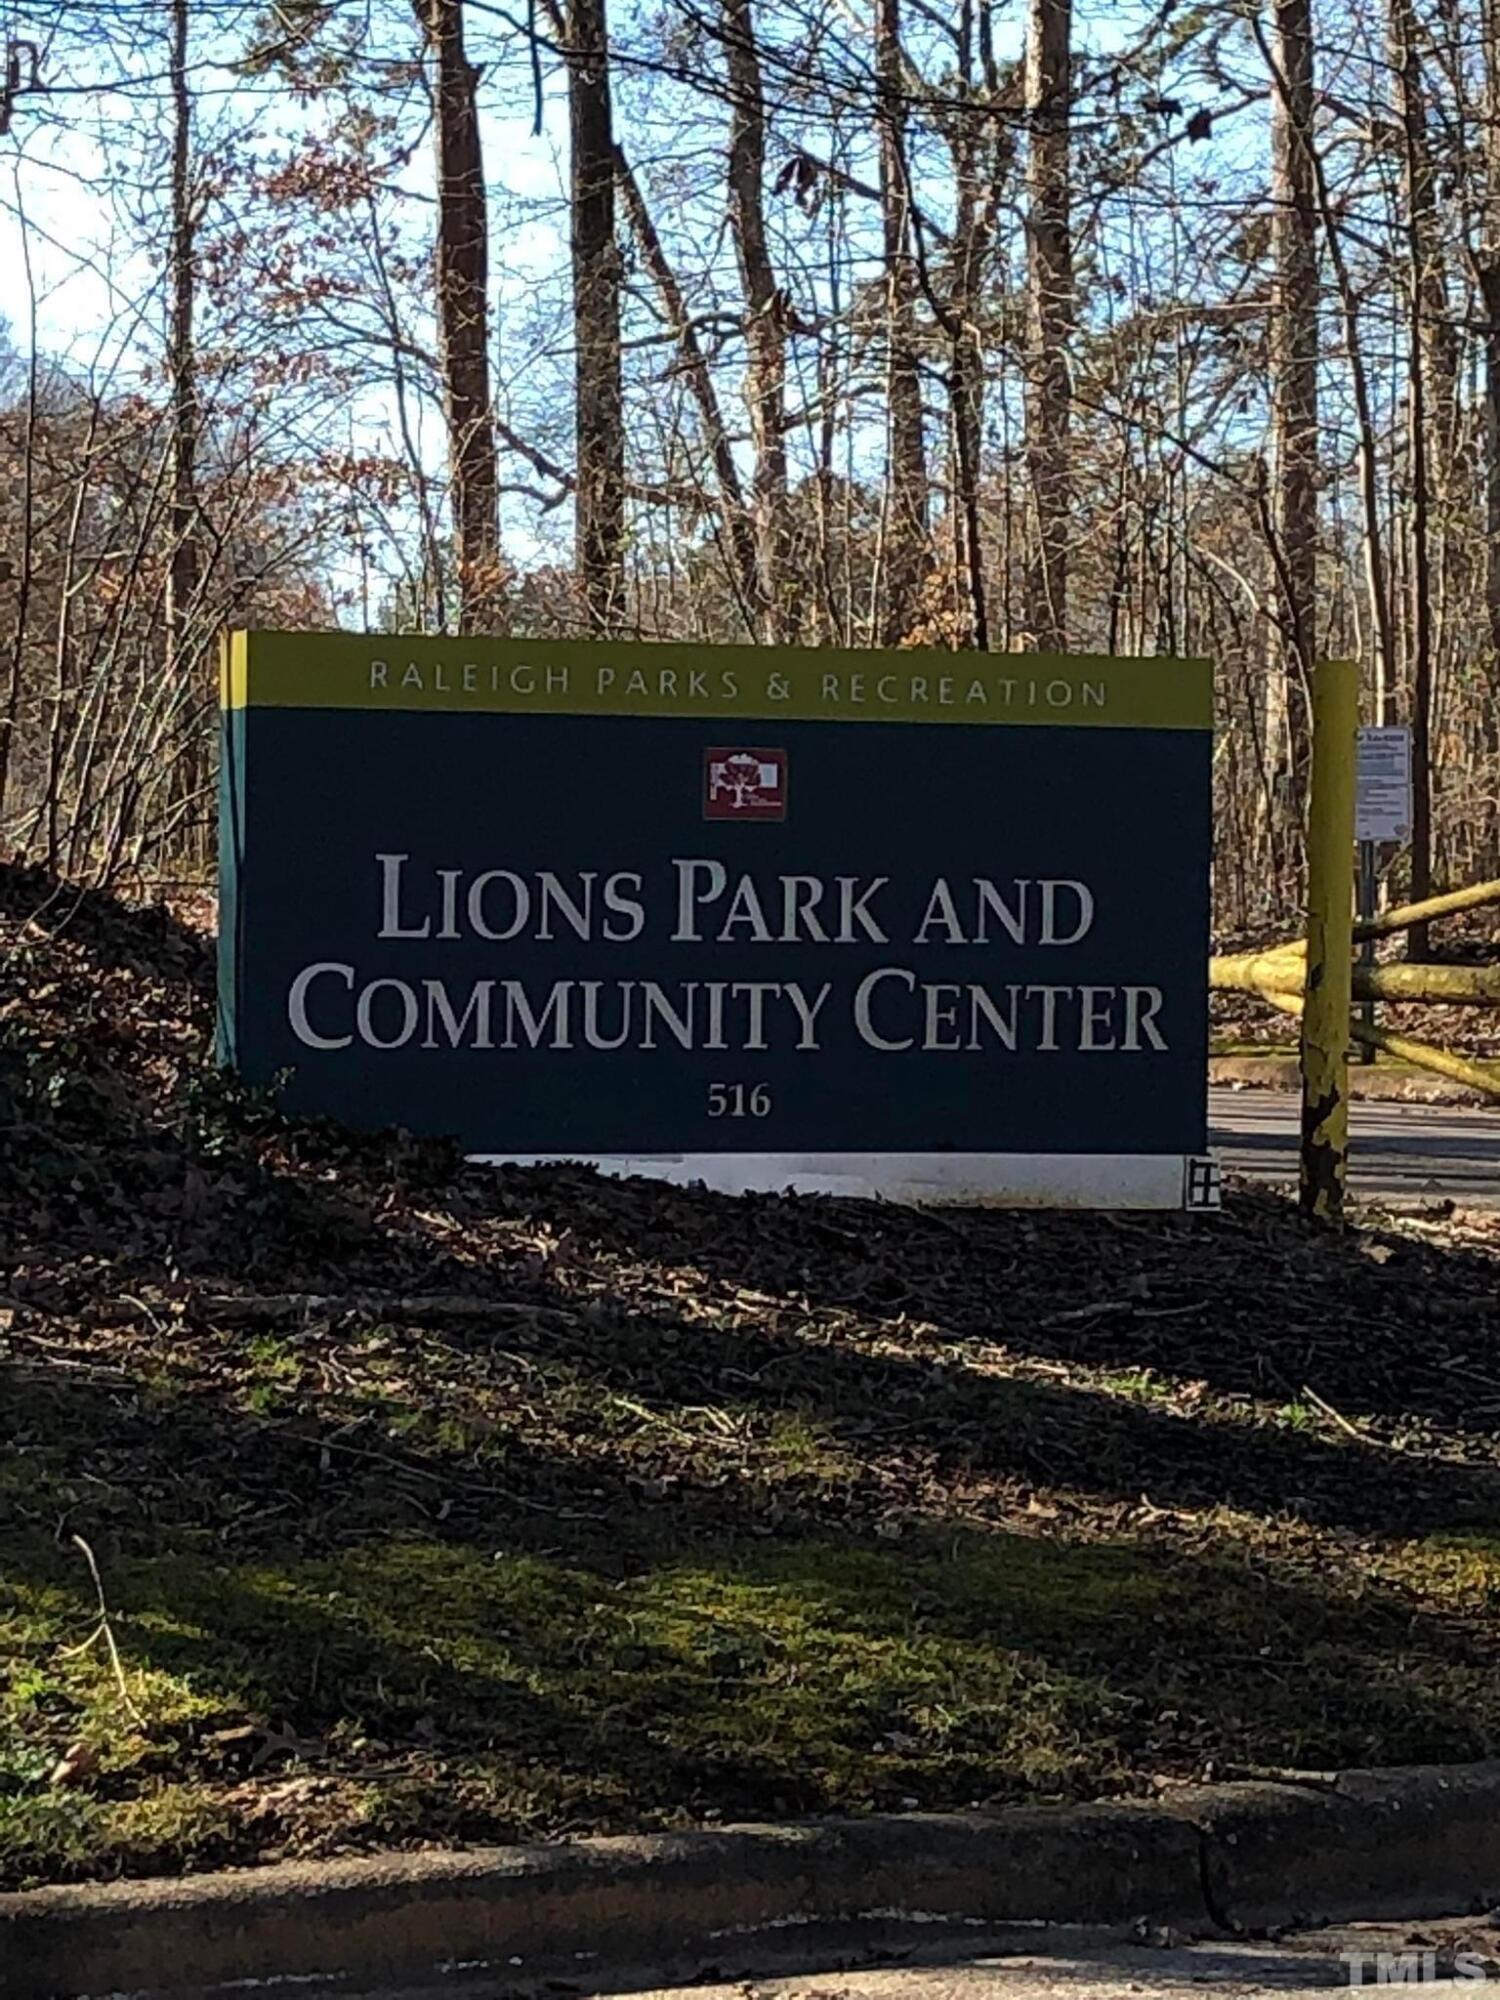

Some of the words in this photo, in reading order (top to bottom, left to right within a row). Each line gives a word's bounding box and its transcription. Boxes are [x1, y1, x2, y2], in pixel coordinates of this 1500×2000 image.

[370, 661, 569, 694] RALEIGH
[597, 667, 739, 701] PARKS
[766, 672, 791, 701] &
[822, 674, 1108, 708] RECREATION
[376, 853, 645, 941] LIONS
[670, 858, 889, 943] PARK
[912, 877, 1096, 946] AND
[288, 962, 832, 1050] COMMUNITY
[854, 968, 1169, 1052] CENTER
[707, 1082, 772, 1118] 516
